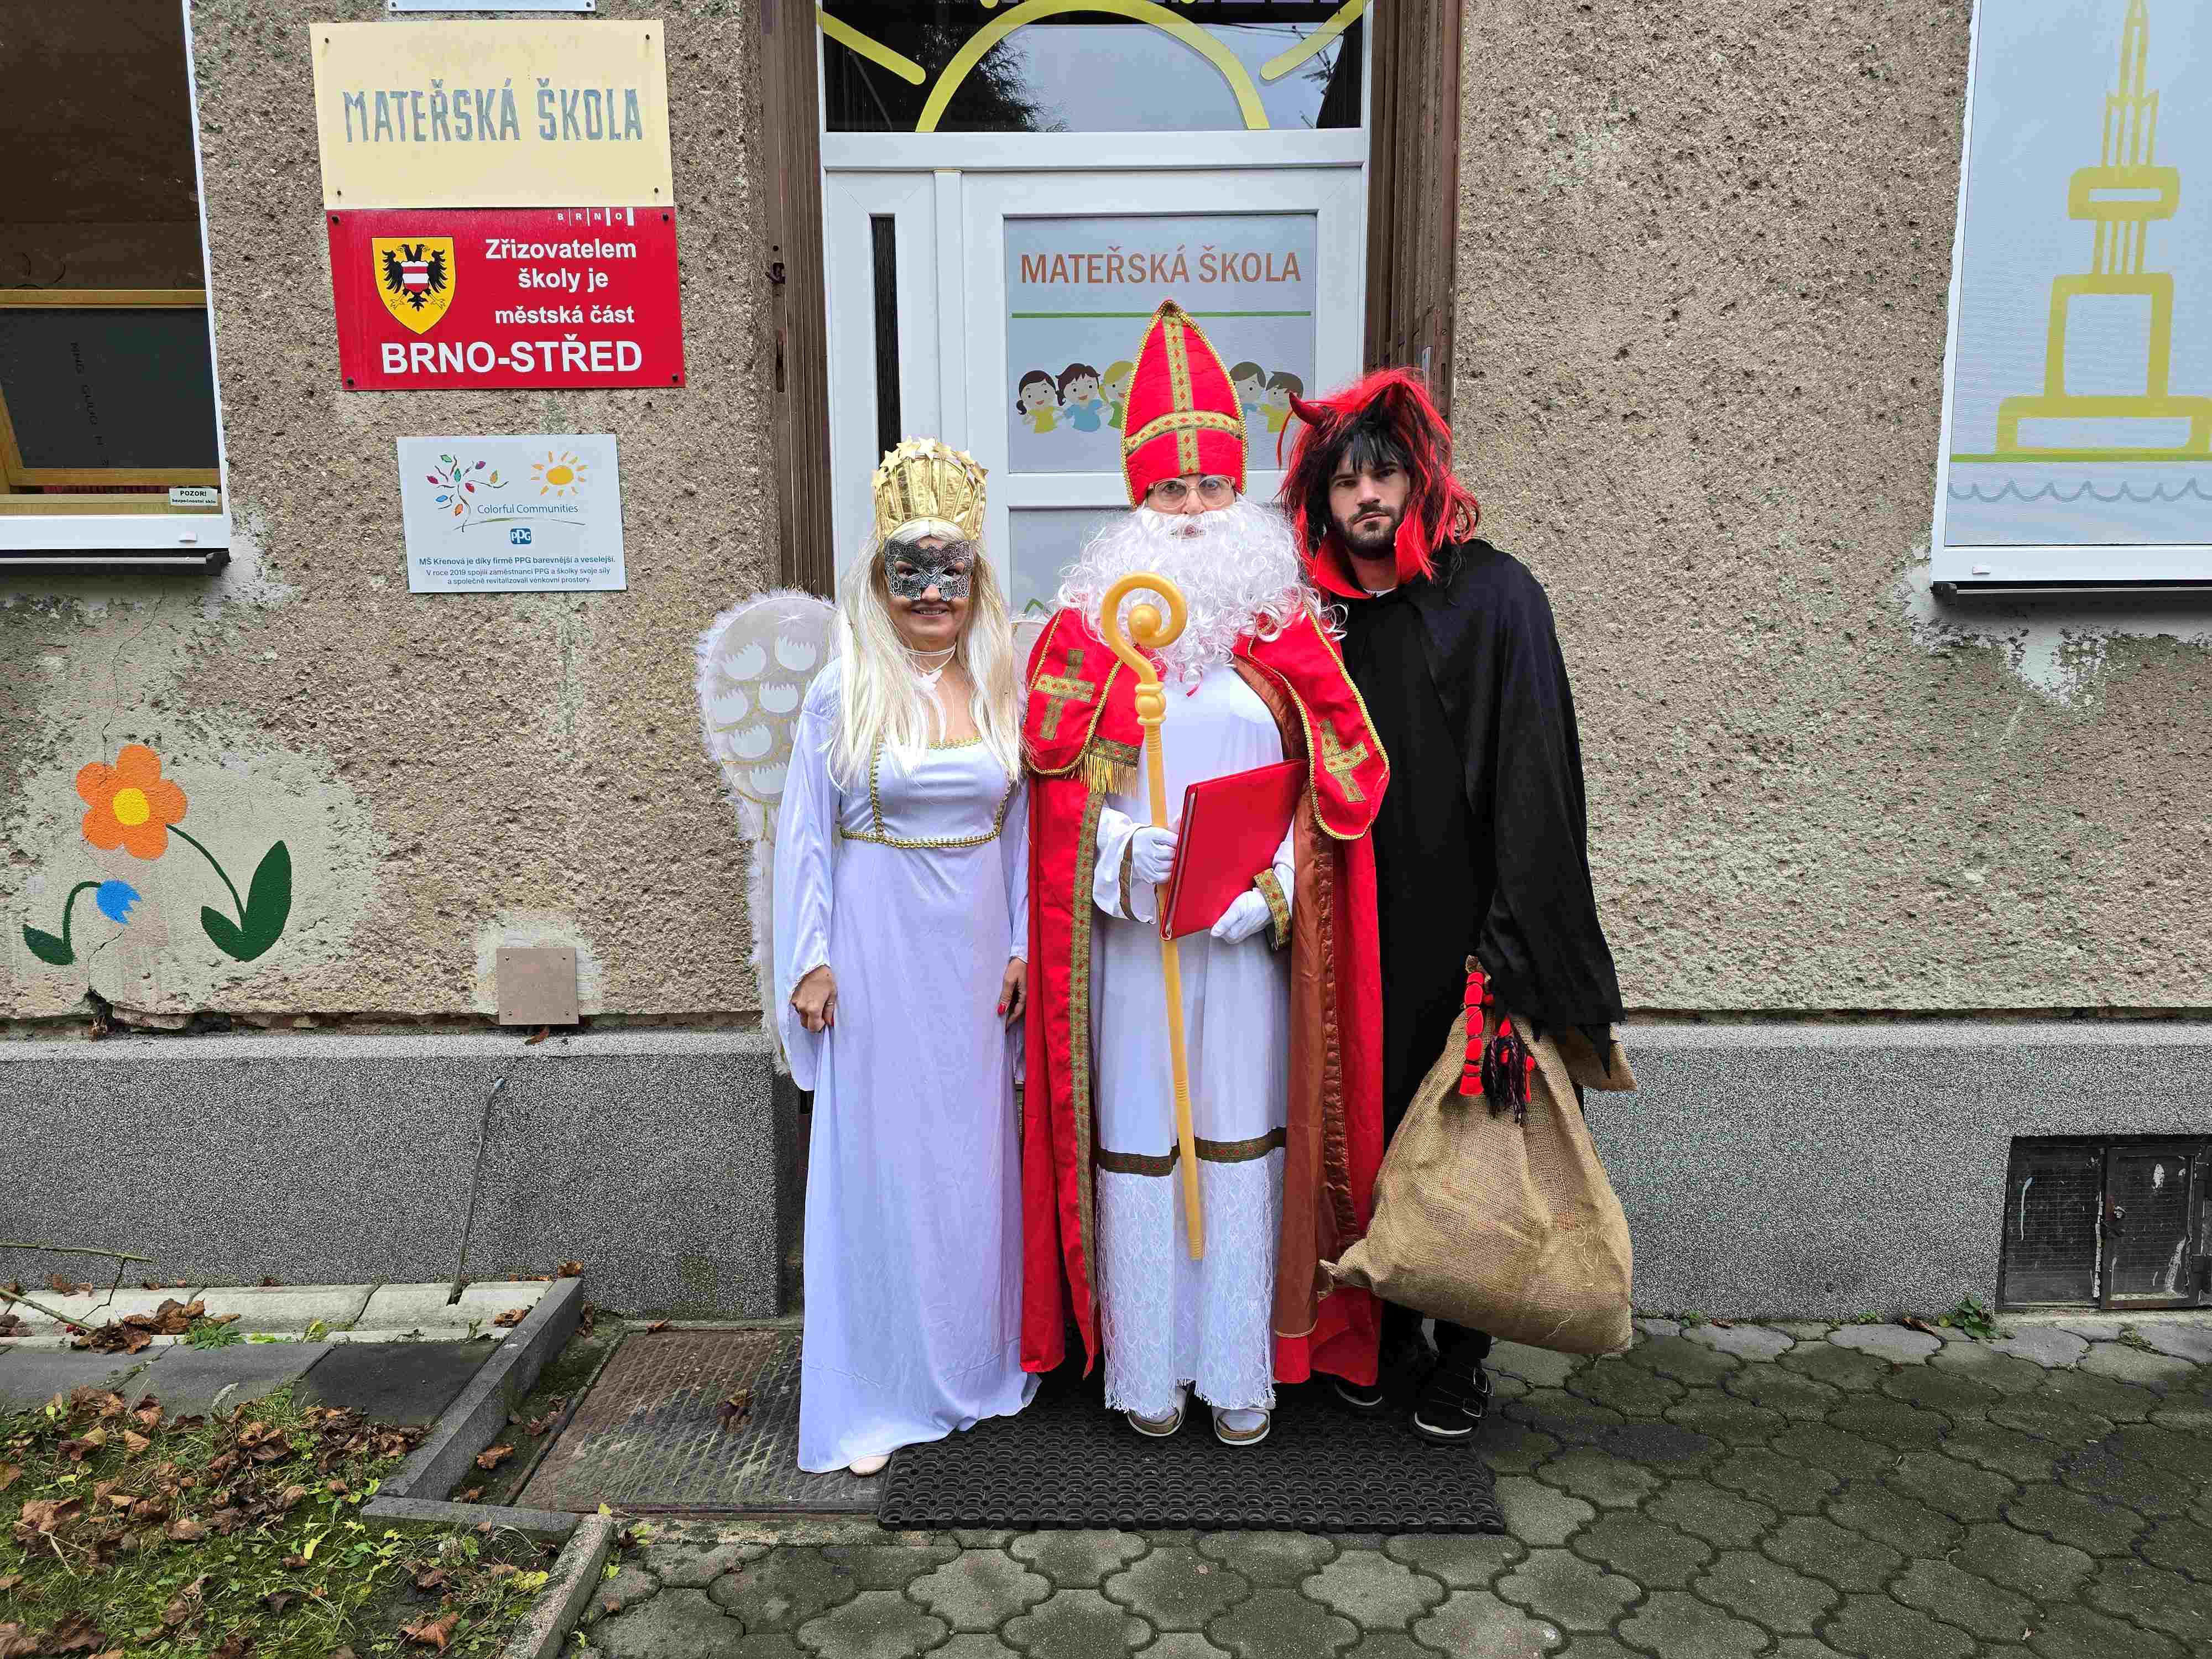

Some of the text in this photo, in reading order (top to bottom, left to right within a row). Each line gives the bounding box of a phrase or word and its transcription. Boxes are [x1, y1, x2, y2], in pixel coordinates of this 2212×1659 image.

[343, 78, 643, 142] MATEŘSKÁ ŠKOLA
[485, 238, 637, 259] Zřizovatelem
[1021, 244, 1302, 284] MATEŘSKÁ ŠKOLA
[518, 268, 609, 293] školy je
[495, 304, 635, 324] městská část
[381, 333, 642, 374] BRNO-STŘED
[477, 504, 578, 514] Colorful Communities
[511, 529, 531, 543] PPG
